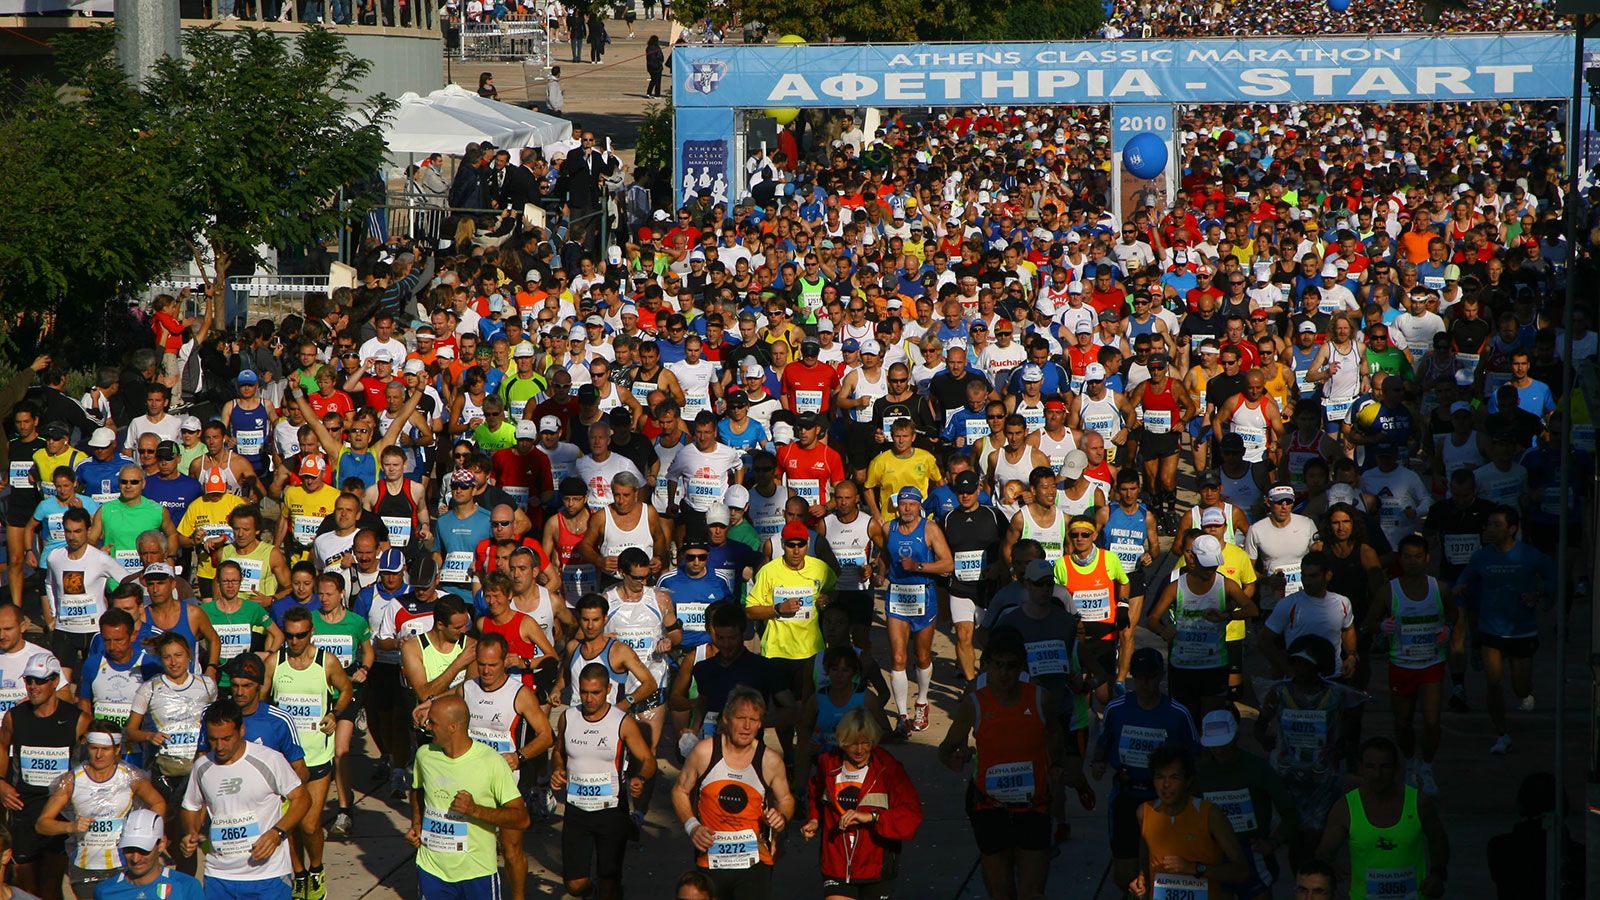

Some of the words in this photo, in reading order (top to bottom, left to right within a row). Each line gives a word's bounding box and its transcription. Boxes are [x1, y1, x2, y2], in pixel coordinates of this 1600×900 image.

[888, 52, 1021, 67] ATHENS
[1036, 49, 1173, 65] CLASSIC
[1187, 48, 1401, 63] MARATHON
[1238, 65, 1533, 97] START
[1120, 116, 1167, 132] 2010
[1091, 421, 1108, 429] 2499
[242, 437, 258, 445] 3037
[695, 487, 713, 495] 2894
[761, 526, 779, 535] 4331
[1450, 543, 1474, 553] 13707
[1117, 552, 1136, 562] 2209
[446, 561, 464, 570] 4221
[961, 560, 980, 569] 3733
[898, 594, 917, 603] 3523
[1082, 599, 1102, 609] 3737
[67, 606, 88, 616] 2391
[286, 705, 311, 717] 2343
[171, 733, 196, 745] 3725
[1128, 738, 1154, 752] 2896
[31, 758, 58, 771] 2582
[988, 767, 1010, 776] ALPHA
[996, 775, 1023, 789] 4310
[577, 786, 601, 797] 4332
[233, 815, 255, 824] BANK
[430, 820, 455, 836] 2344
[221, 826, 248, 841] 2662
[718, 843, 746, 855] 3272
[1156, 878, 1181, 887] ALPHA
[1182, 879, 1206, 888] BANK
[1378, 881, 1407, 895] 3056
